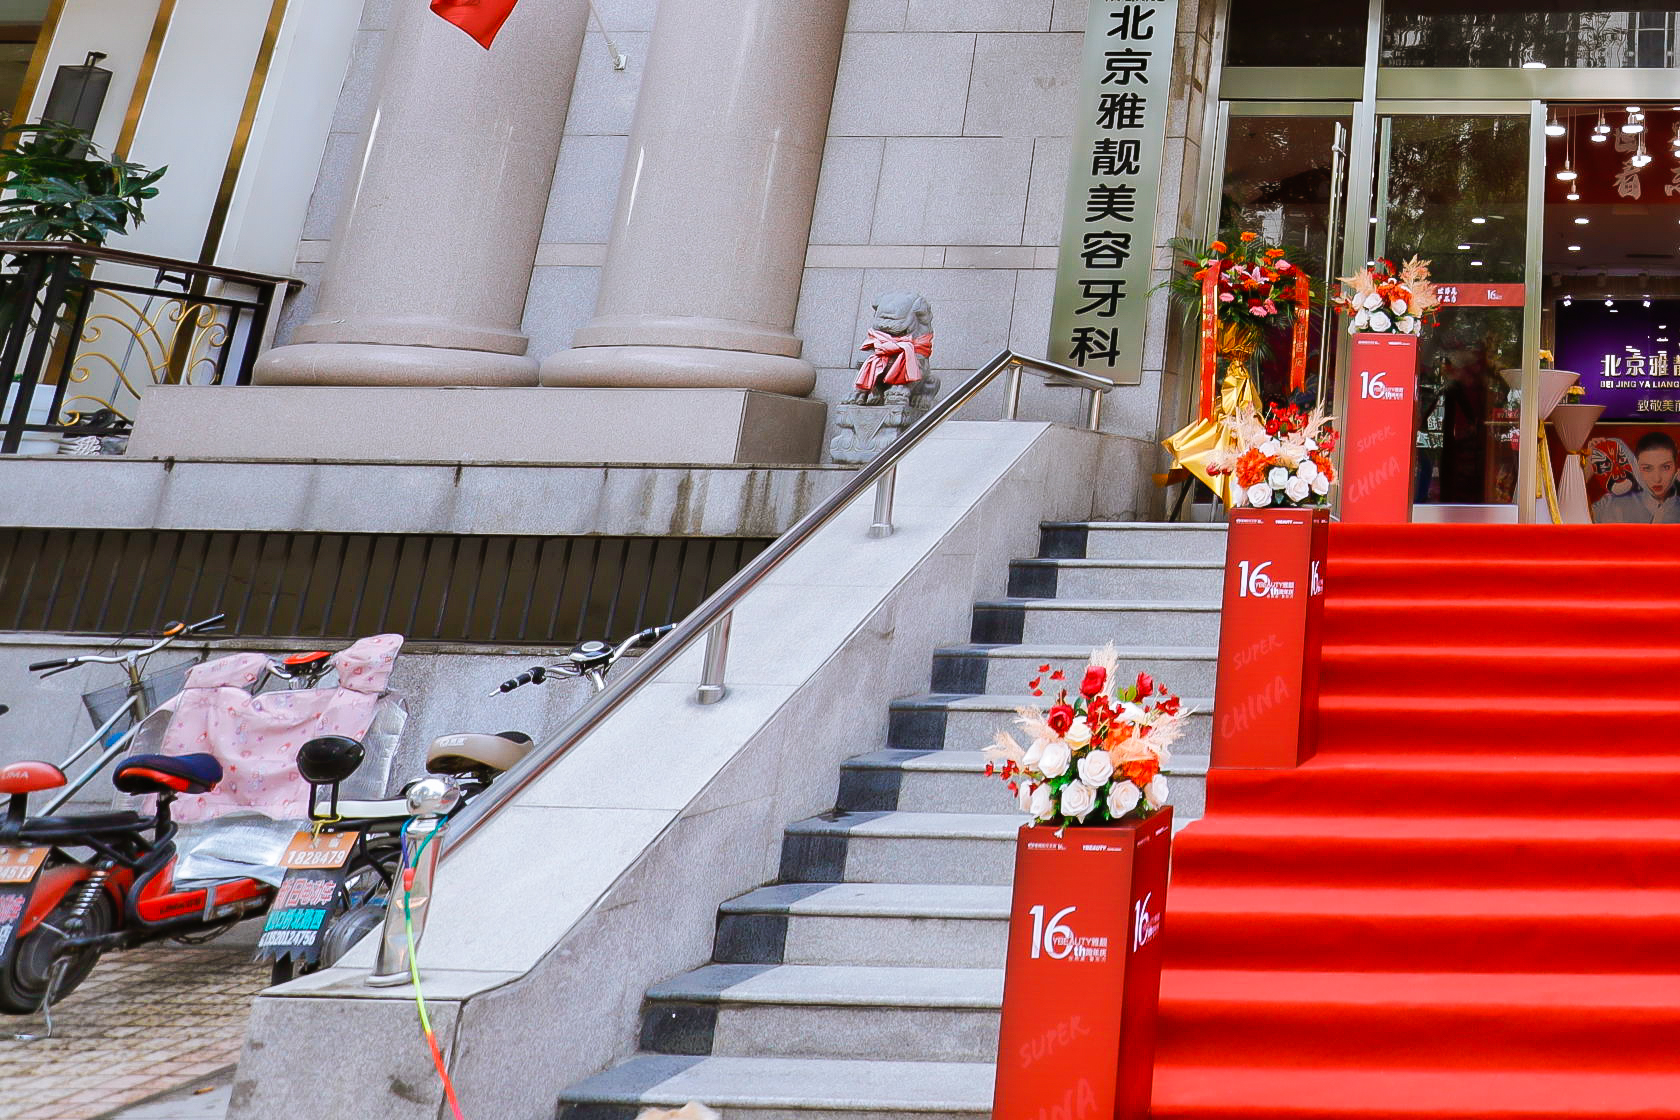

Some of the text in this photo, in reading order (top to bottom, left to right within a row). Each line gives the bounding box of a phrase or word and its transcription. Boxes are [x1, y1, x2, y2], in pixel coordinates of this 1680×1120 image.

[1068, 4, 1157, 368] 北京雅靓美容牙科
[1360, 371, 1387, 399] 16
[1639, 380, 1651, 389] YA
[1652, 380, 1680, 389] LIANG
[1348, 455, 1401, 503] CHINA
[1238, 560, 1272, 597] 16
[1232, 633, 1285, 671] SUPER
[1220, 675, 1290, 741] CHINA
[287, 850, 345, 865] 1828479
[1029, 904, 1077, 959] 16
[1133, 890, 1152, 953] 16
[1018, 1015, 1091, 1069] SUPER
